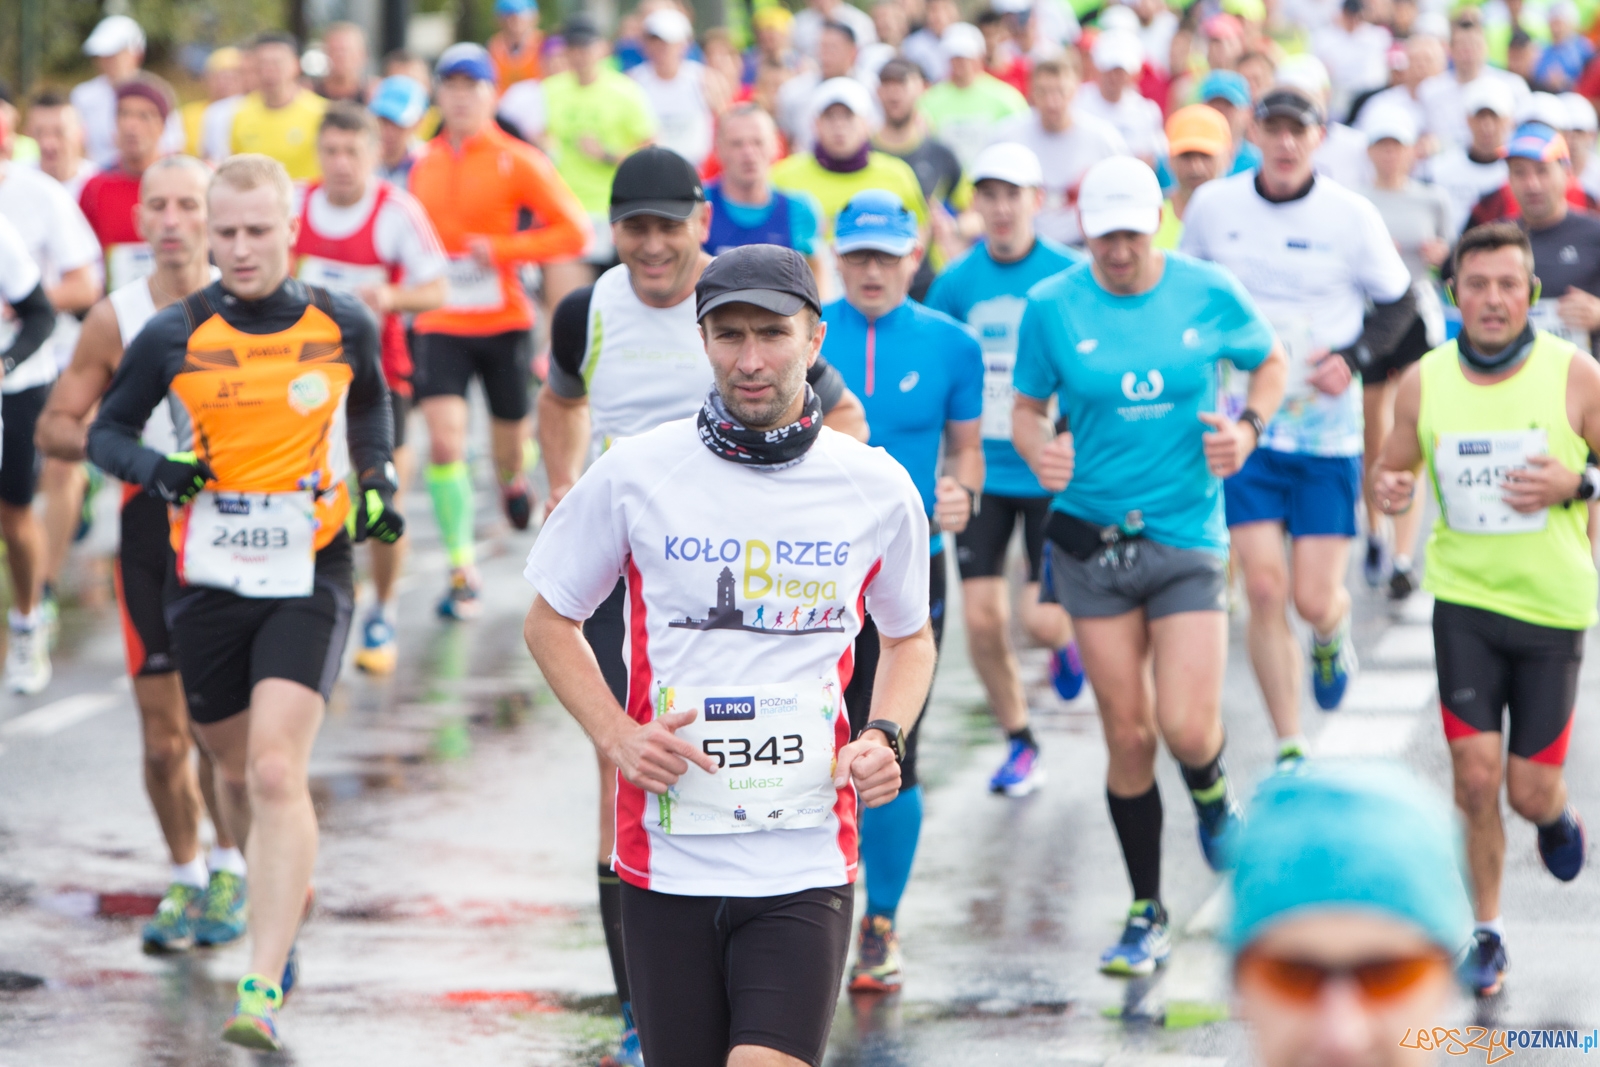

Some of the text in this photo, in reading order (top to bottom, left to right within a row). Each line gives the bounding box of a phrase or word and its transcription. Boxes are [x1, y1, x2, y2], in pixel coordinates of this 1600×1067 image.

[212, 526, 289, 548] 2483
[709, 701, 752, 715] 17.PKO
[760, 703, 798, 715] maraton
[702, 734, 805, 769] 5343
[728, 777, 784, 790] Łukasz
